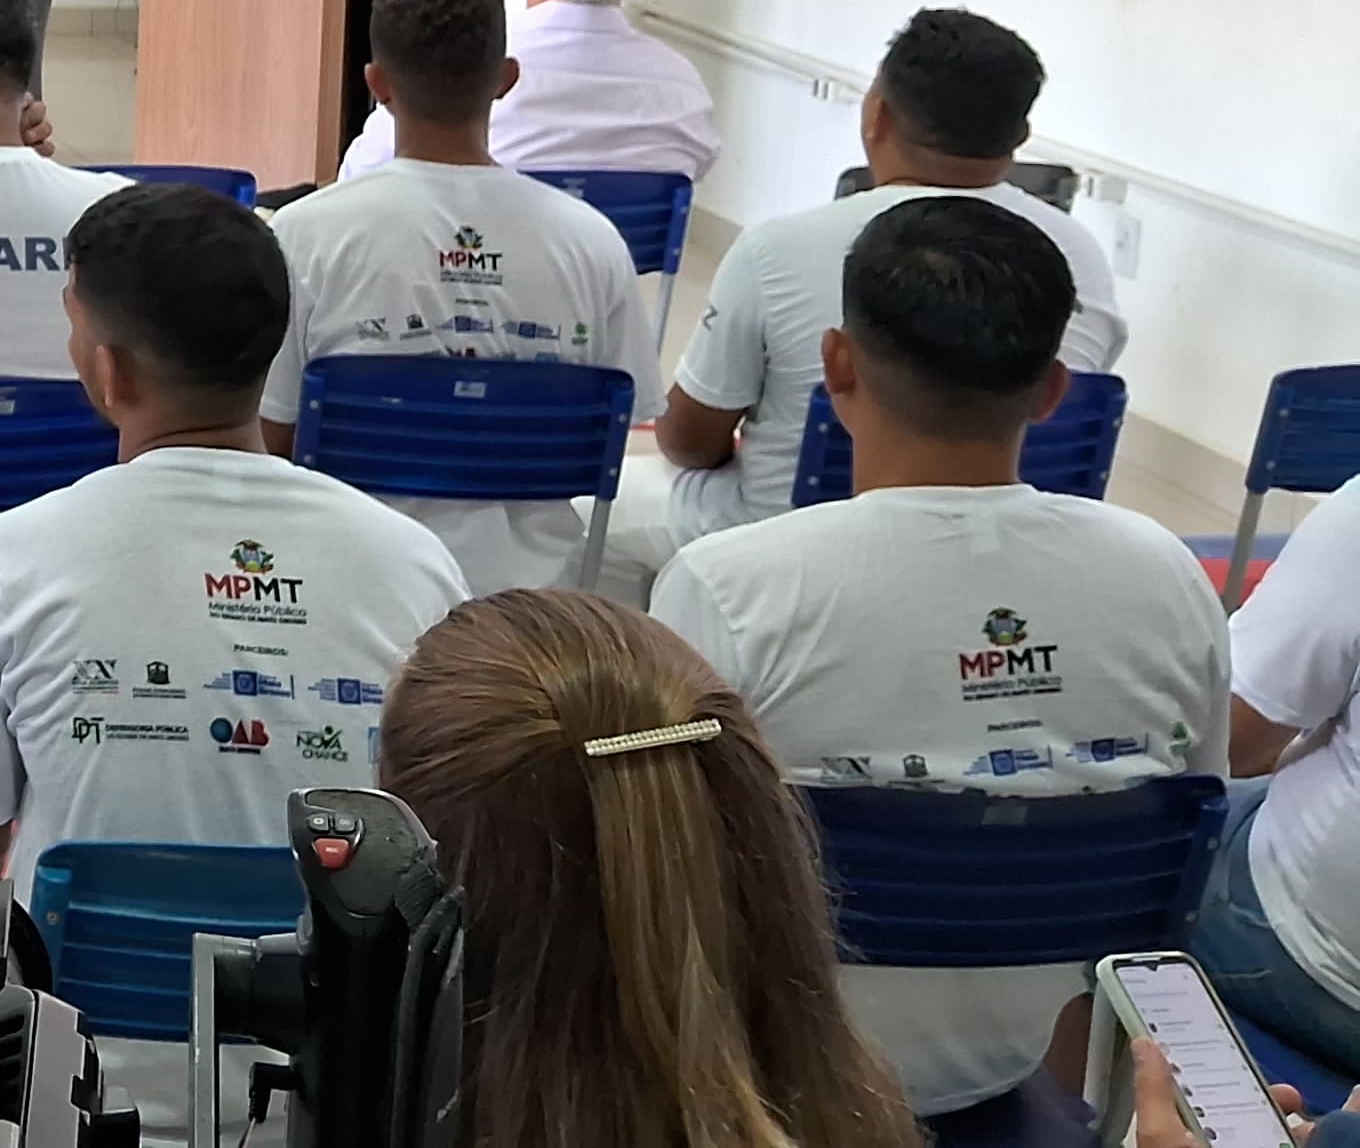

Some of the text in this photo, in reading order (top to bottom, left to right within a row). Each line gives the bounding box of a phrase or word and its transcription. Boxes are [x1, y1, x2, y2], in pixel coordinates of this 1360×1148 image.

[439, 251, 503, 271] MPMT
[205, 573, 303, 603] MPMT
[959, 645, 1058, 680] MPMT
[210, 717, 269, 747] OAB
[296, 725, 343, 750] NOVA
